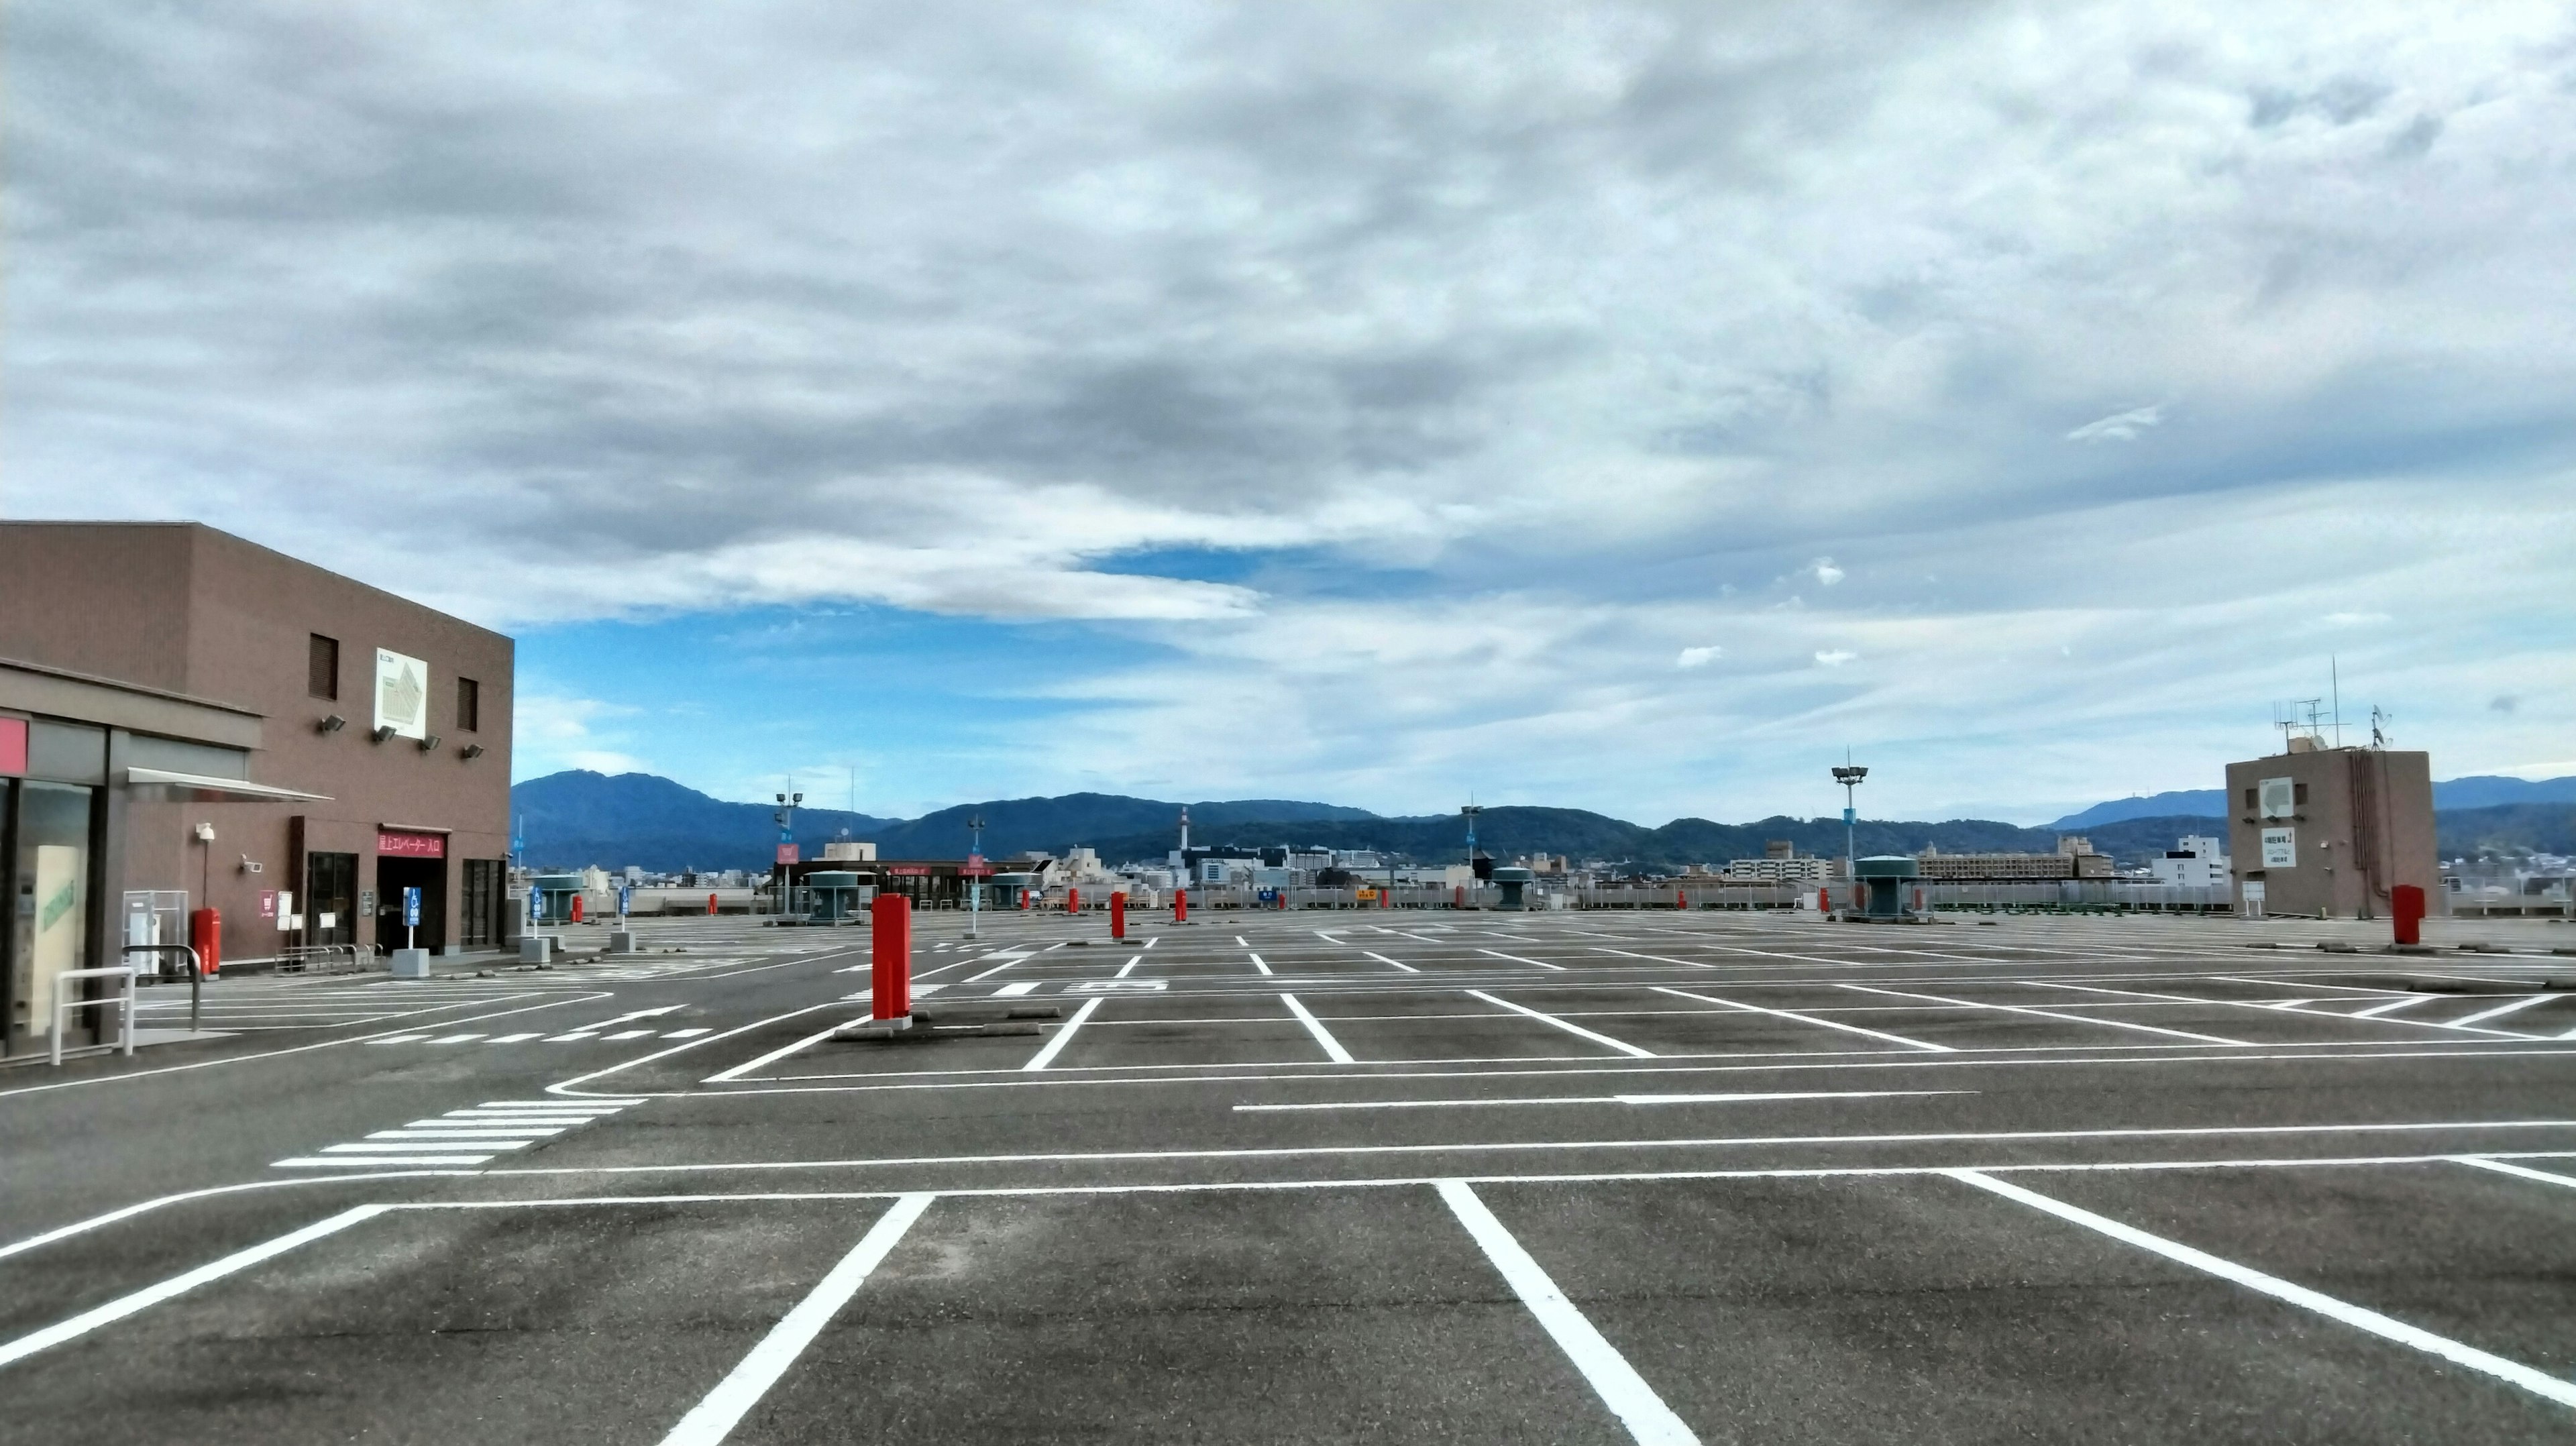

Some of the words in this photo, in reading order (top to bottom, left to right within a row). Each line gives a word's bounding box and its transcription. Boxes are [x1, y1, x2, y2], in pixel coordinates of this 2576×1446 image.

[379, 835, 425, 852] 屋上エレベーター
[427, 839, 440, 852] 入口
